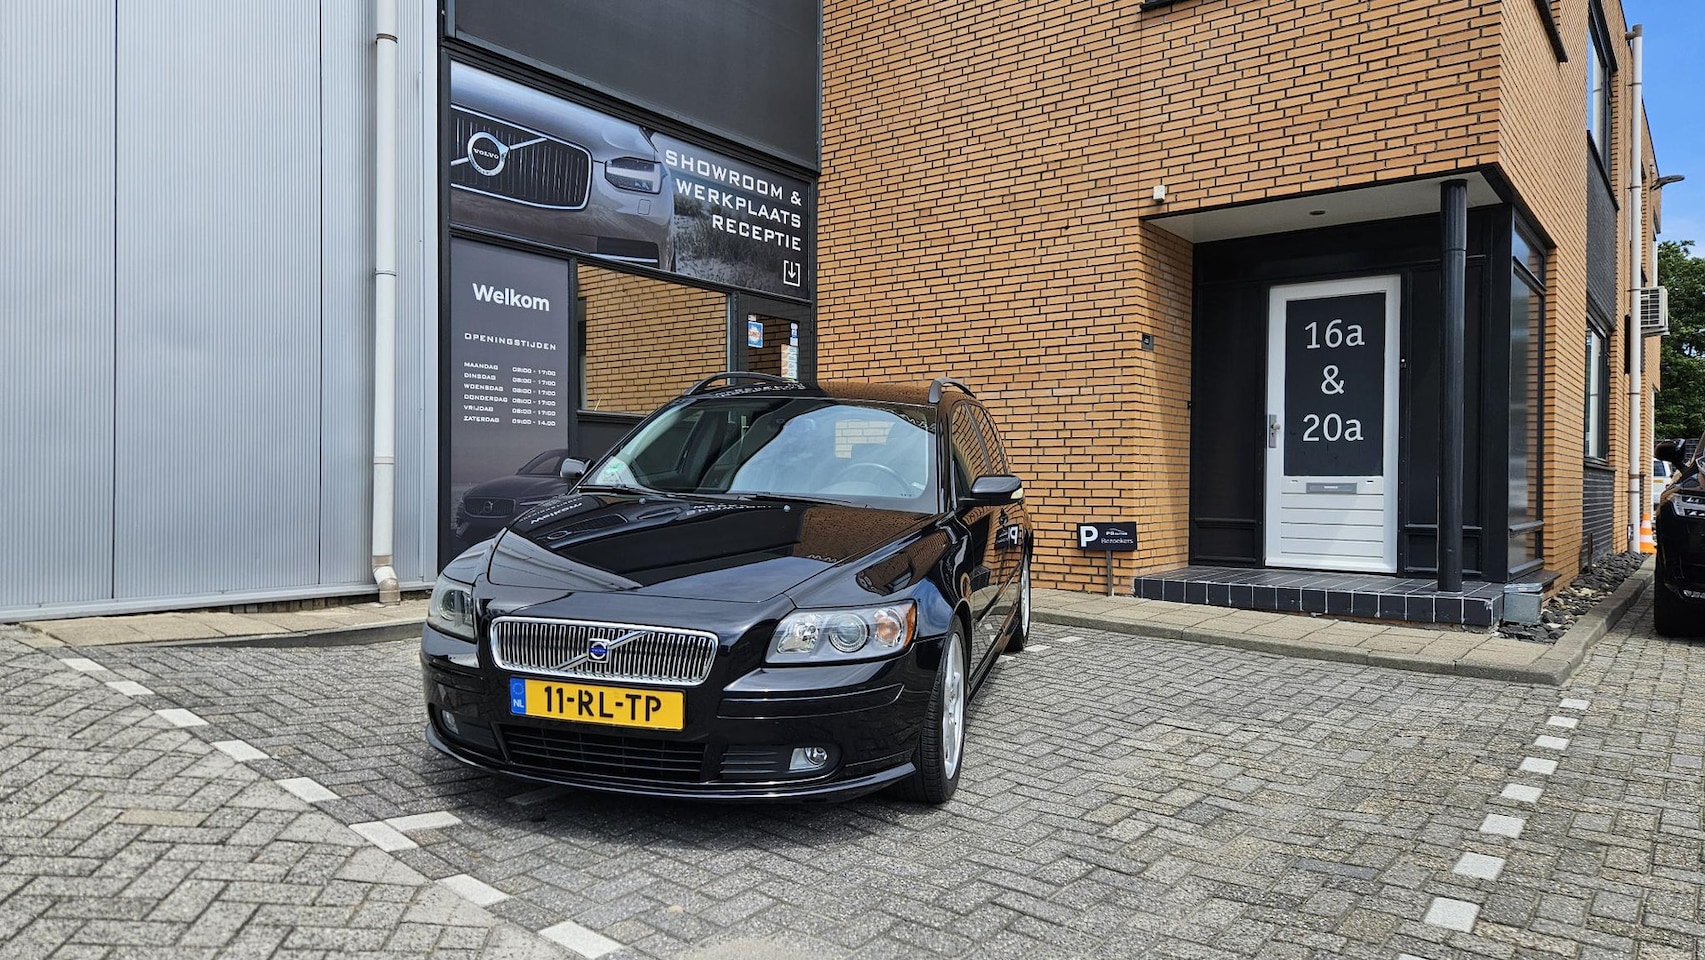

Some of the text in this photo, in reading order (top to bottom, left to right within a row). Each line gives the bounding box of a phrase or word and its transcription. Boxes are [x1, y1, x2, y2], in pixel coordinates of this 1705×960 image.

[472, 148, 499, 159] VOLVO
[666, 150, 801, 206] SHOWROOM &
[676, 178, 801, 228] WERKPLAATS
[712, 214, 801, 251] RECEPTIE
[472, 283, 550, 311] Welkom
[464, 332, 556, 350] OPENINGSTIJDEN
[1304, 319, 1365, 349] 16a
[464, 362, 498, 370] MAANDAG
[1320, 364, 1345, 394] &
[464, 383, 503, 392] WOENSDAG
[464, 394, 508, 402] DONDERDAG
[1302, 413, 1364, 442] 20a
[1080, 526, 1098, 547] P
[513, 686, 662, 722] NL 11-RL-TP
